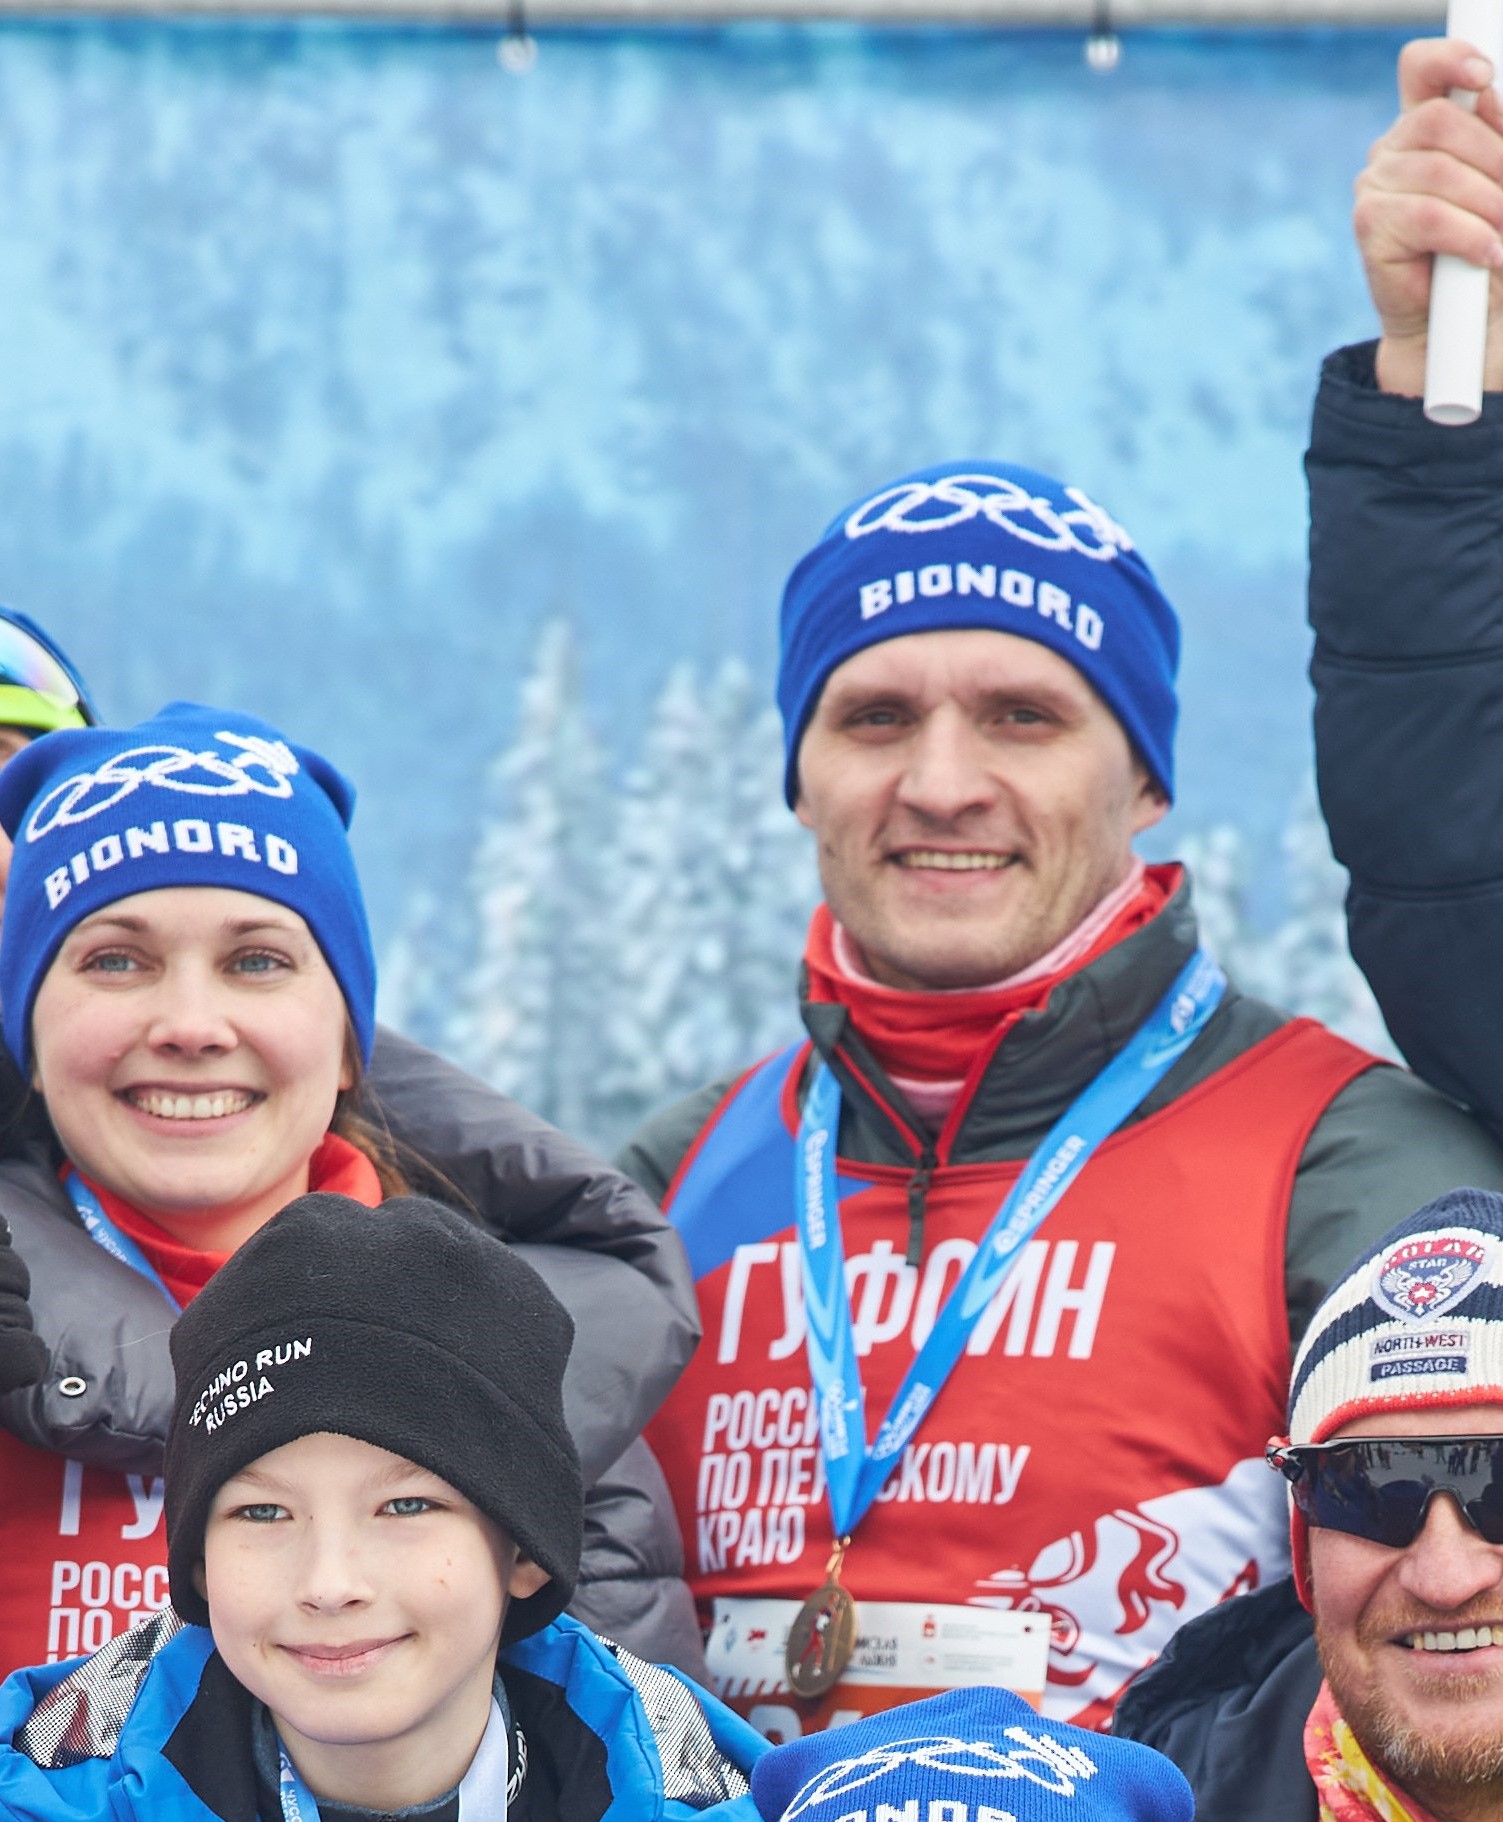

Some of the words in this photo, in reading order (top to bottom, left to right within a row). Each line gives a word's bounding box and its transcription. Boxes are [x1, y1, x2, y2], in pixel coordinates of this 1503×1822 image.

[858, 563, 1104, 650] BIONORD
[43, 818, 300, 910] BIONORD
[255, 1337, 313, 1371] RUN
[1380, 1357, 1460, 1377] PASSAGE
[205, 1376, 275, 1435] RUSSIA
[697, 1451, 752, 1512] ПО
[696, 1506, 806, 1574] КРАЮ
